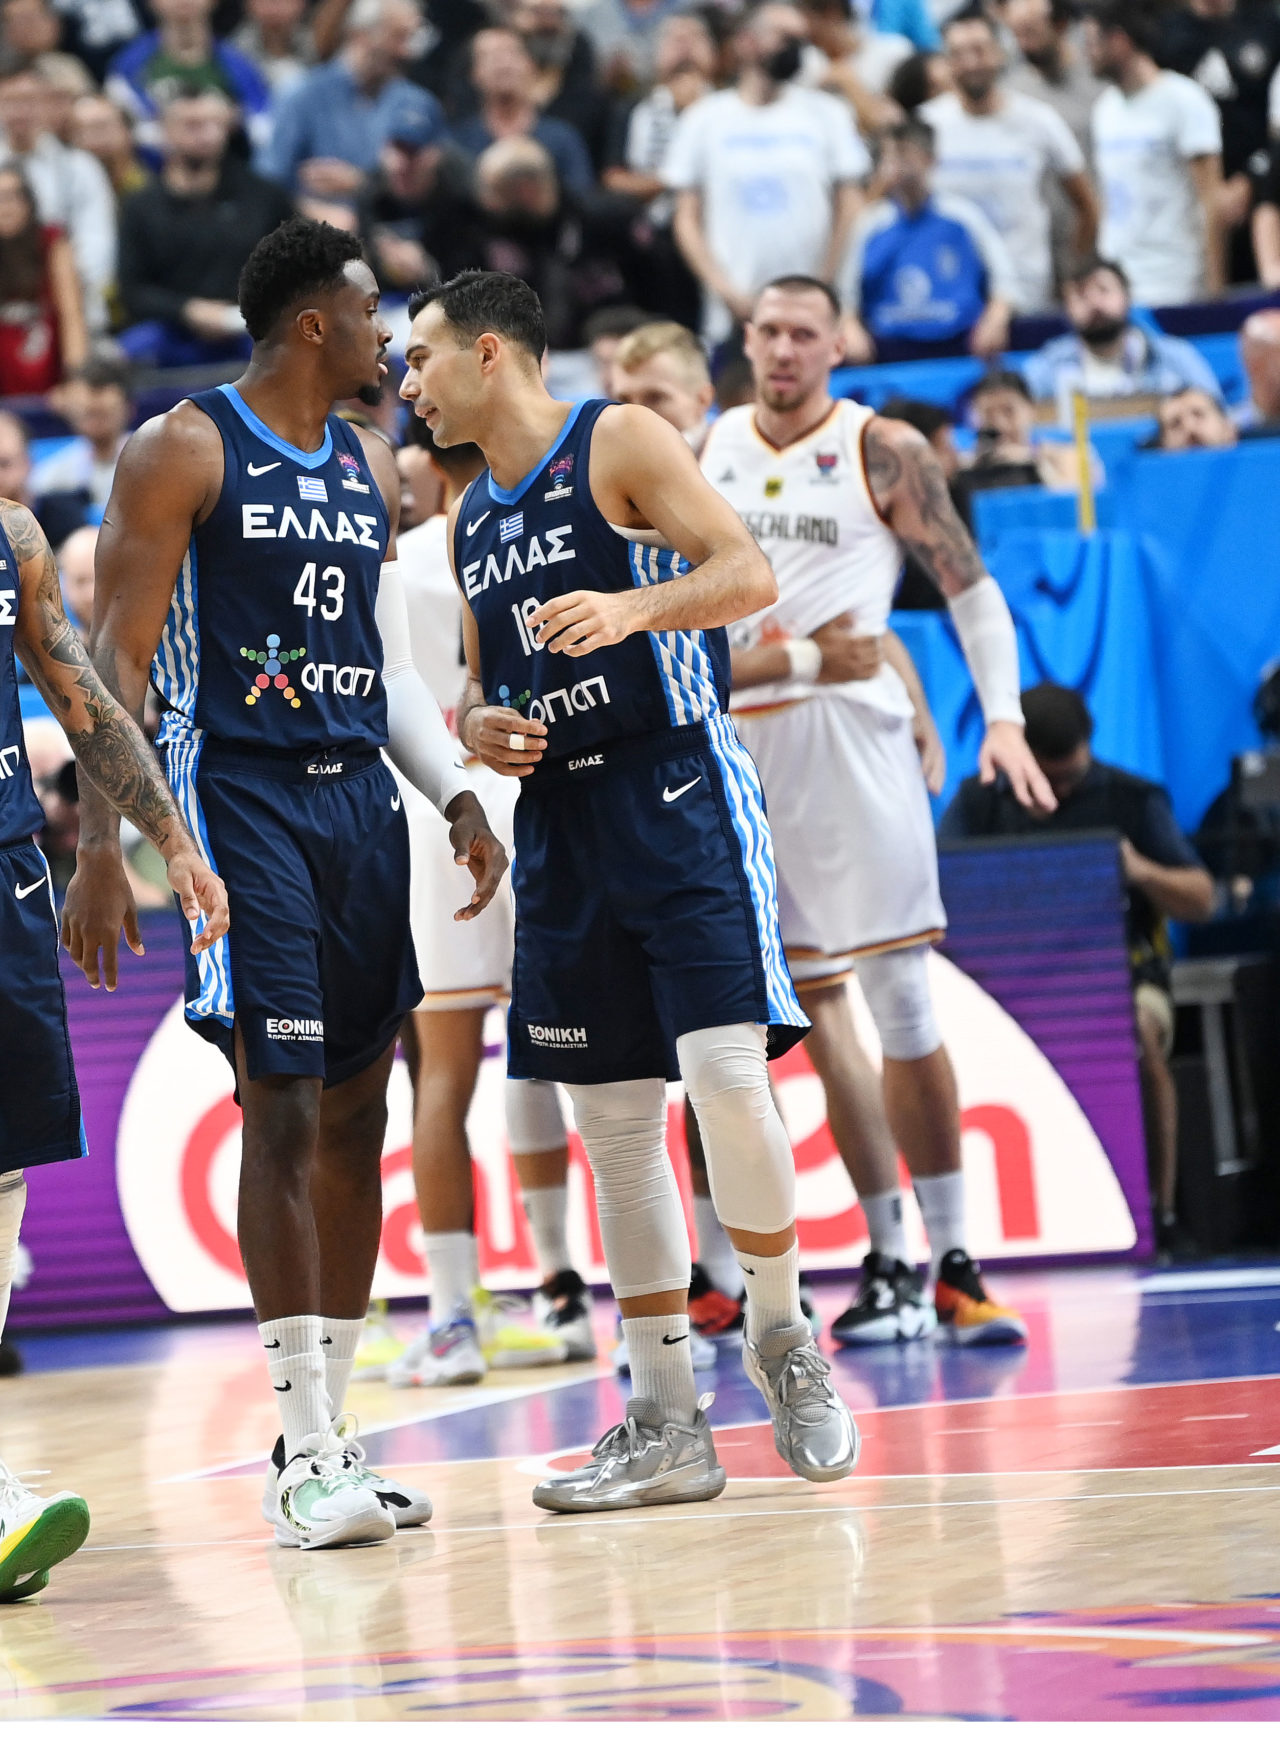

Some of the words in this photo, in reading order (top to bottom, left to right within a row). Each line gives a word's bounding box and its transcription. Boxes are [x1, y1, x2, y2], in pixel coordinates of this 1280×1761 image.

[242, 504, 379, 550] ΕΛΛΑΣ
[741, 511, 838, 547] SCHLAND
[463, 524, 576, 600] ΕΛΛΑΣ
[293, 562, 346, 621] 43
